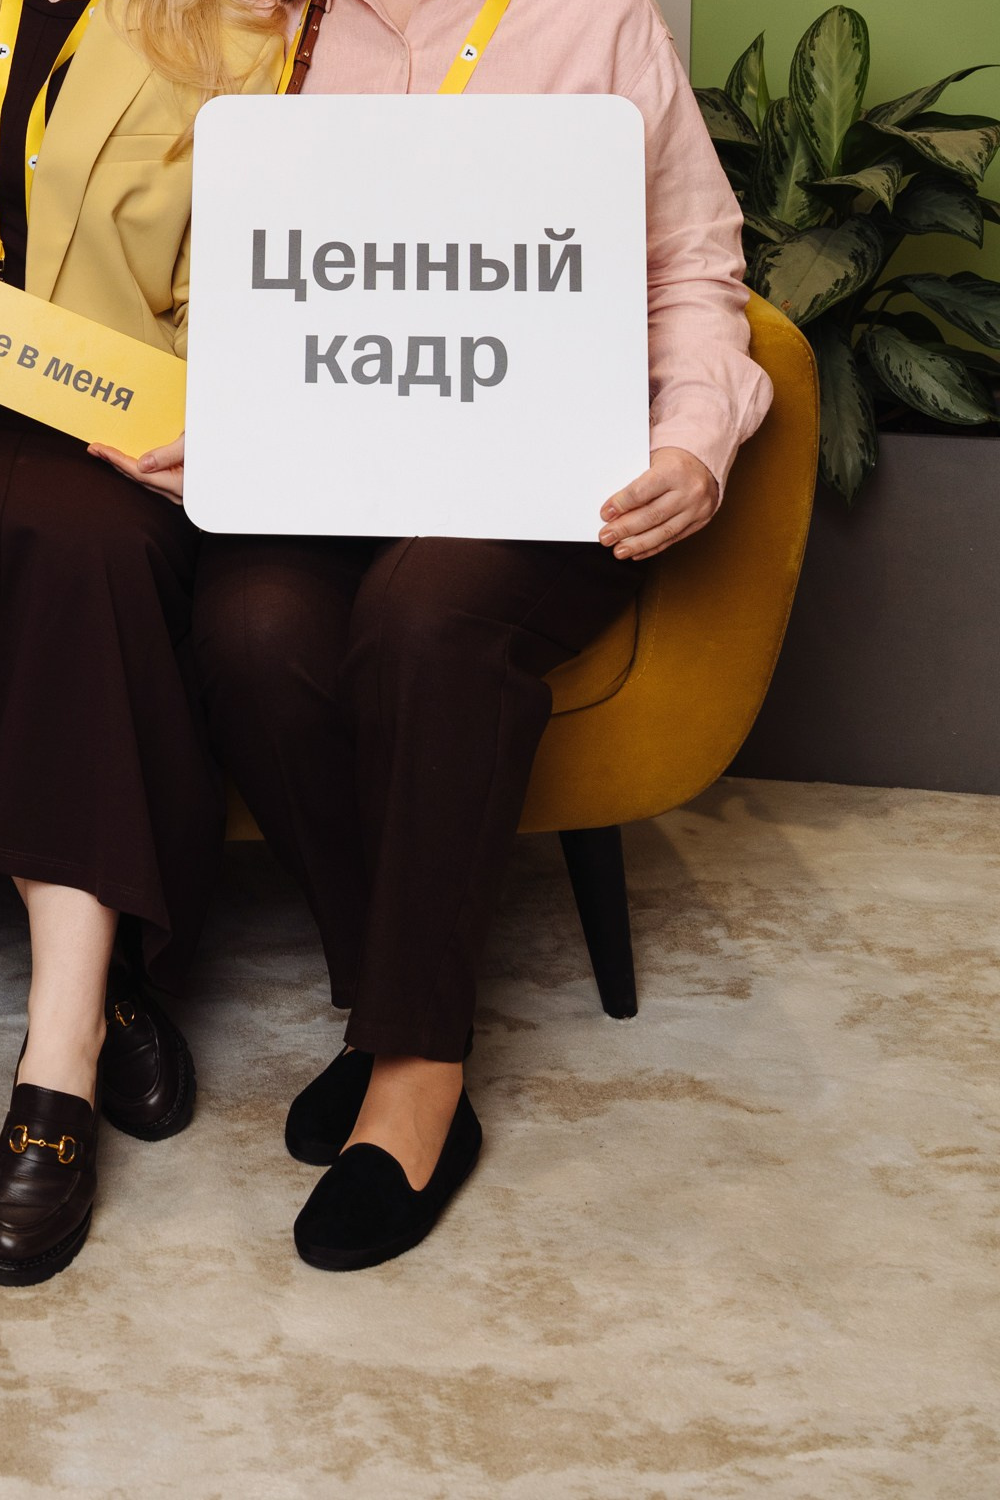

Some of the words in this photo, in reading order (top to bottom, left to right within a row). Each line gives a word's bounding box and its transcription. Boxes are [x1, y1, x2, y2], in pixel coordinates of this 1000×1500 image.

[252, 228, 583, 302] Ценный
[16, 344, 39, 369] в
[42, 356, 135, 412] меня
[304, 334, 508, 402] кадр
